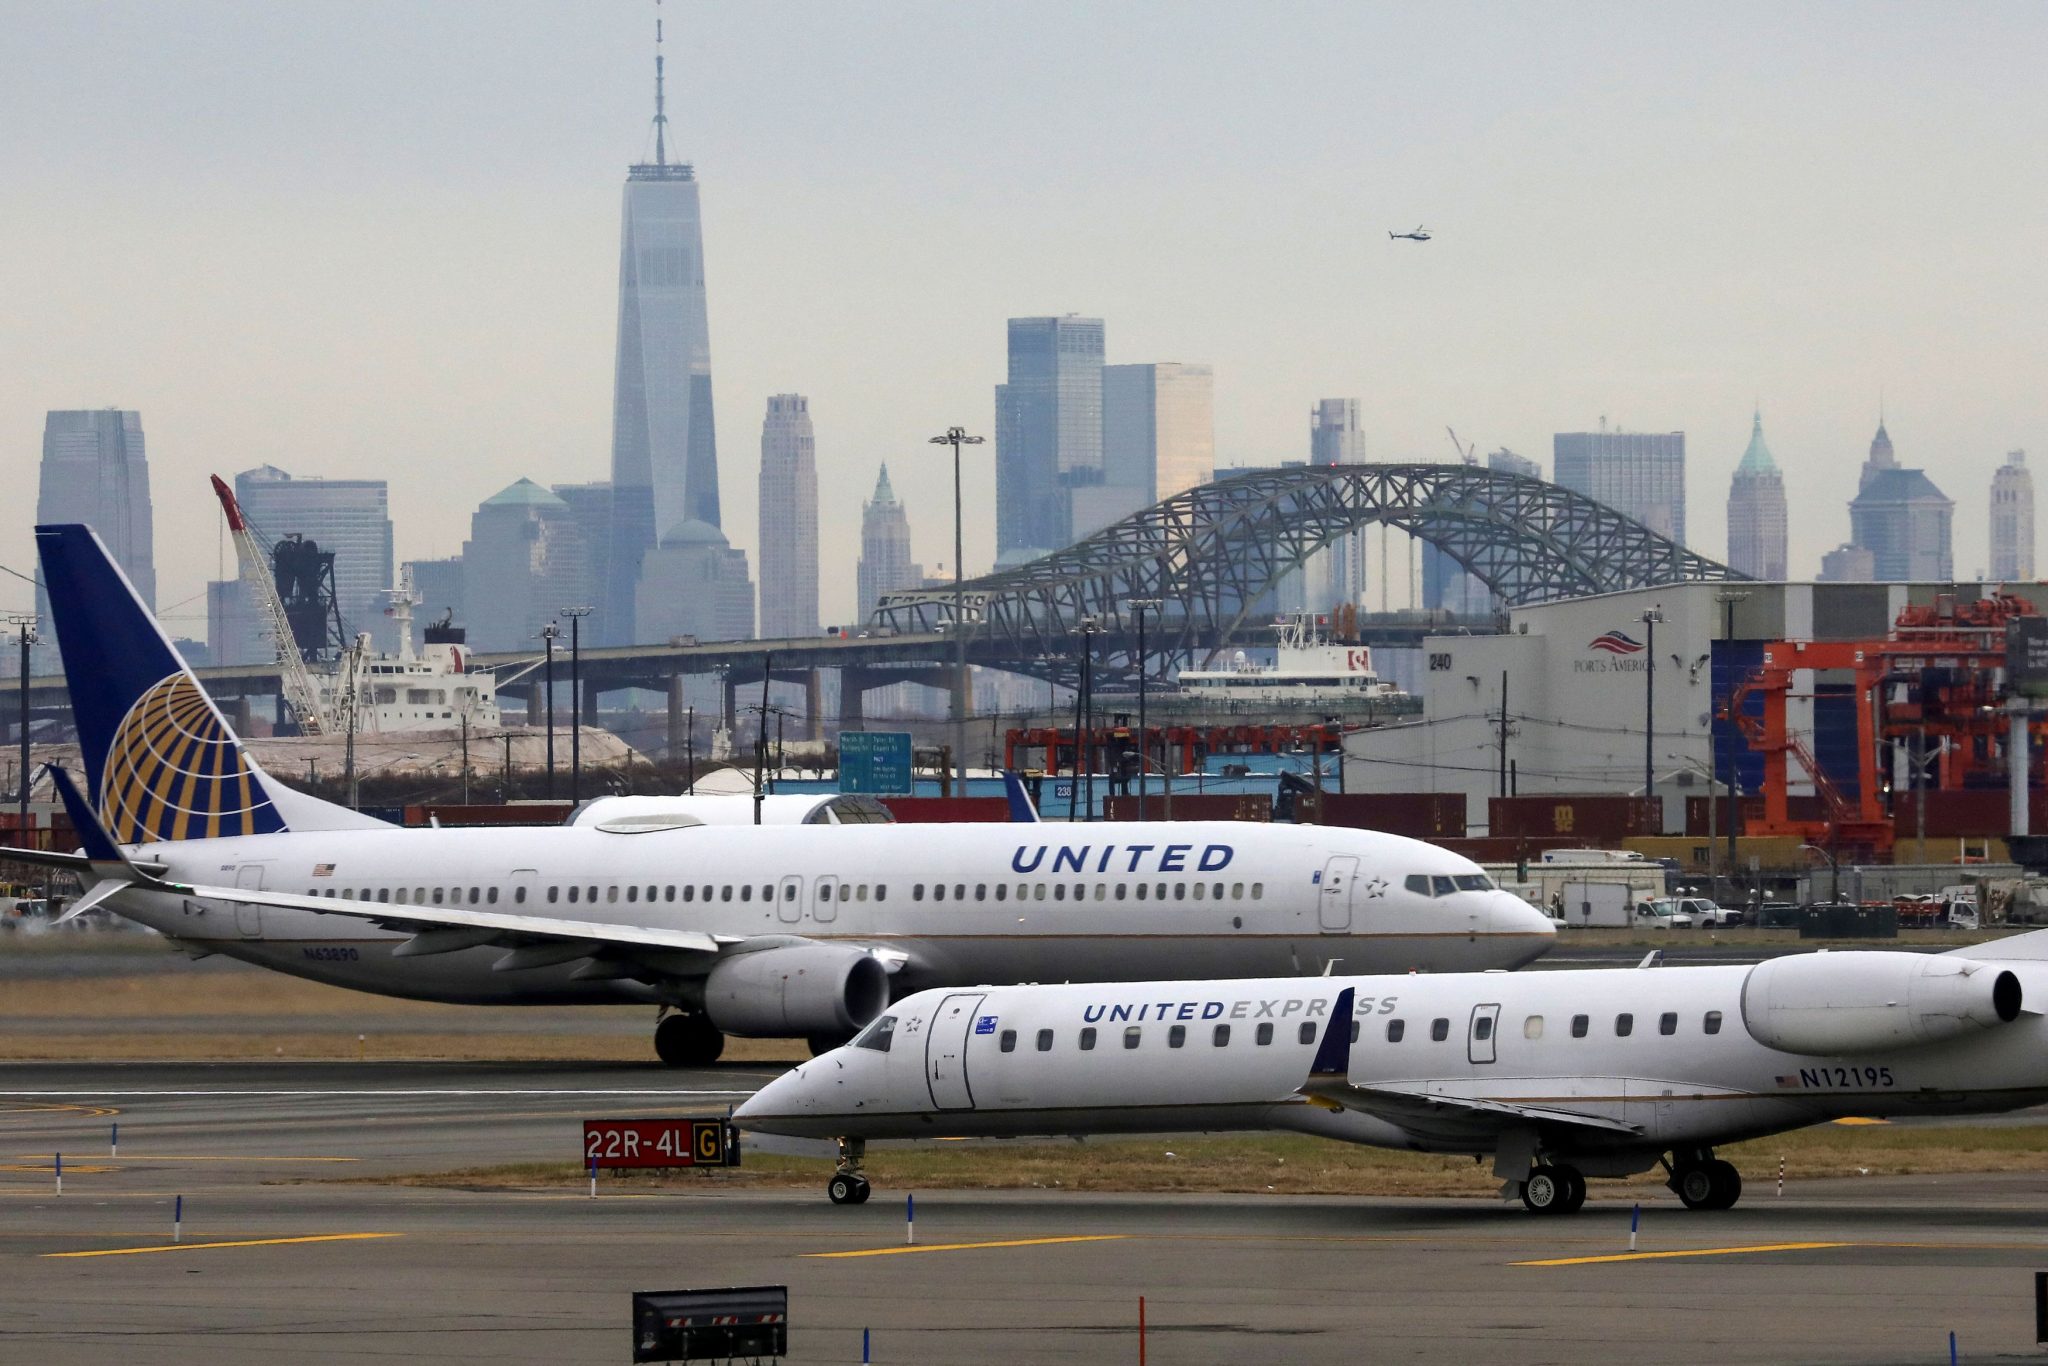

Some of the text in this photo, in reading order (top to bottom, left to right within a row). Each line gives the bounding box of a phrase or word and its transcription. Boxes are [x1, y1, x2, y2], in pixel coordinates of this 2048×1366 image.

[1430, 653, 1451, 671] 240
[1574, 659, 1607, 673] PORTS
[1057, 786, 1072, 797] 238
[1011, 844, 1234, 873] UNITED
[302, 947, 359, 962] N63890
[1800, 1067, 1894, 1088] N12195
[587, 1128, 716, 1158] 22R-4L G
